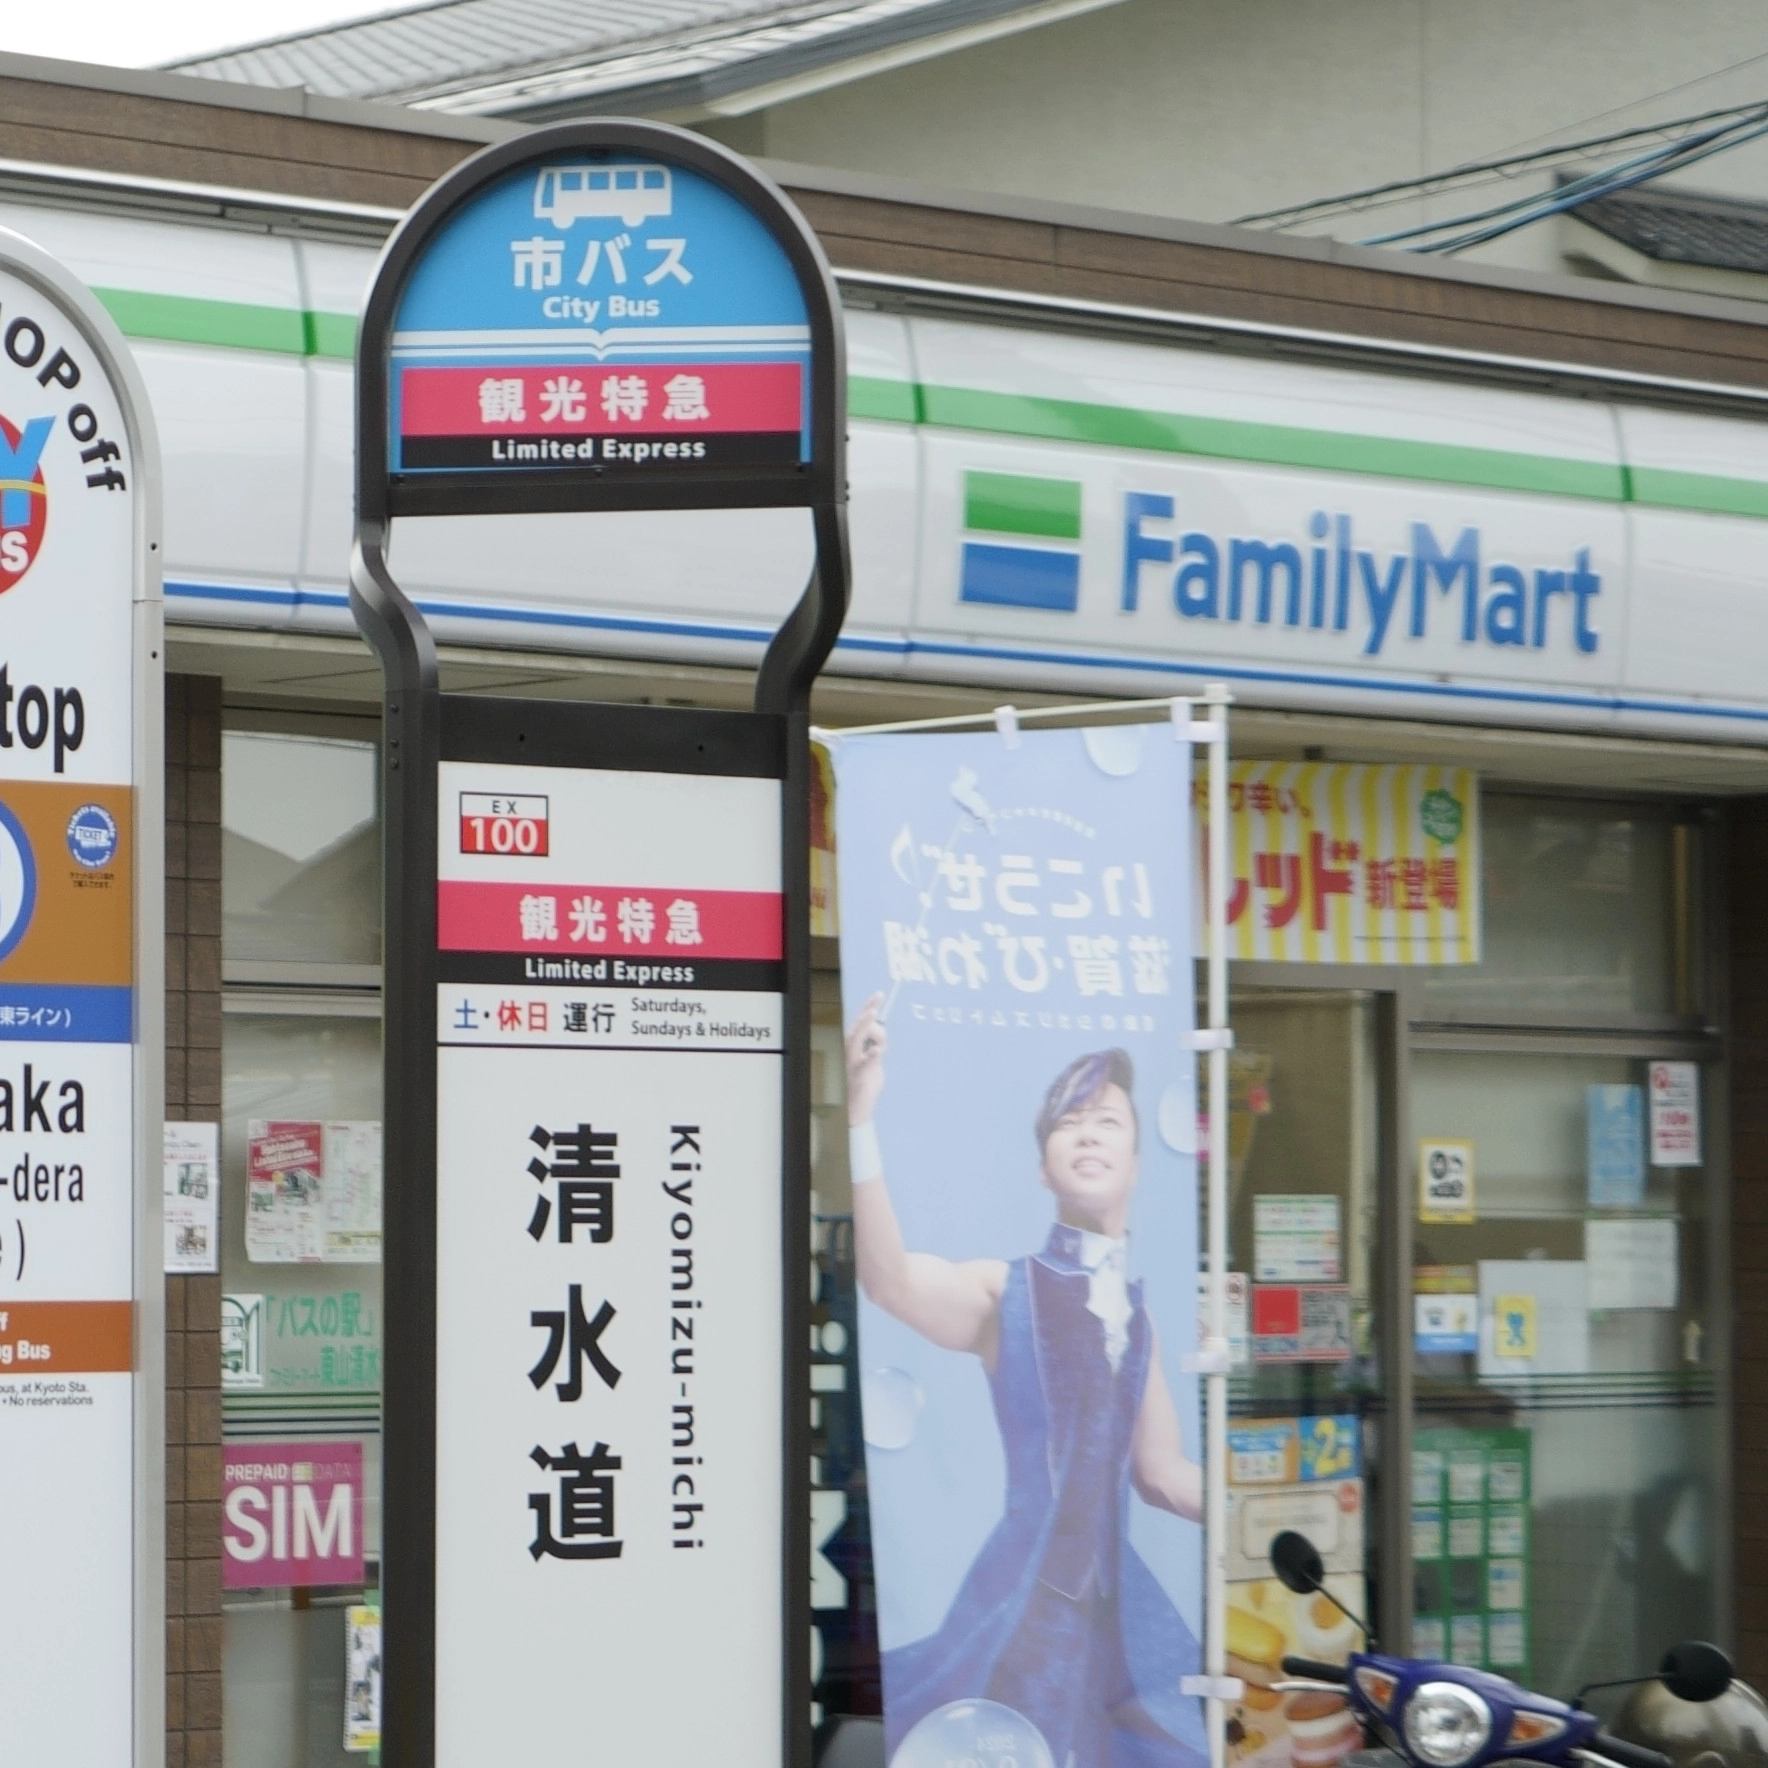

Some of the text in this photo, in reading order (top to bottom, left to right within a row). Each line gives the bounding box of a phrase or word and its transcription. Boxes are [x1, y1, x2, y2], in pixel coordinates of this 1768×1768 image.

[511, 233, 694, 291] 市バス
[542, 295, 660, 323] City Bus
[478, 375, 711, 424] 観光特急
[68, 402, 126, 492] off
[491, 437, 706, 463] Limited Express
[1120, 489, 1602, 657] FamilyMart
[470, 817, 538, 853] 100
[519, 894, 703, 946] 観光特急
[525, 958, 695, 986] Limited Express
[453, 998, 616, 1033] 土・休日 運行
[631, 997, 707, 1017] Saturdays,
[631, 1020, 771, 1040] Sundays & Holidays
[17, 1340, 51, 1360] Bus
[525, 1123, 623, 1562] 清水道
[661, 1124, 703, 1550] Kiyomizu-michi
[21, 1385, 32, 1394] at
[34, 1383, 66, 1396] Kyoto
[26, 1396, 93, 1406] reservations
[225, 1463, 287, 1481] PREPAID
[224, 1483, 352, 1561] SIM
